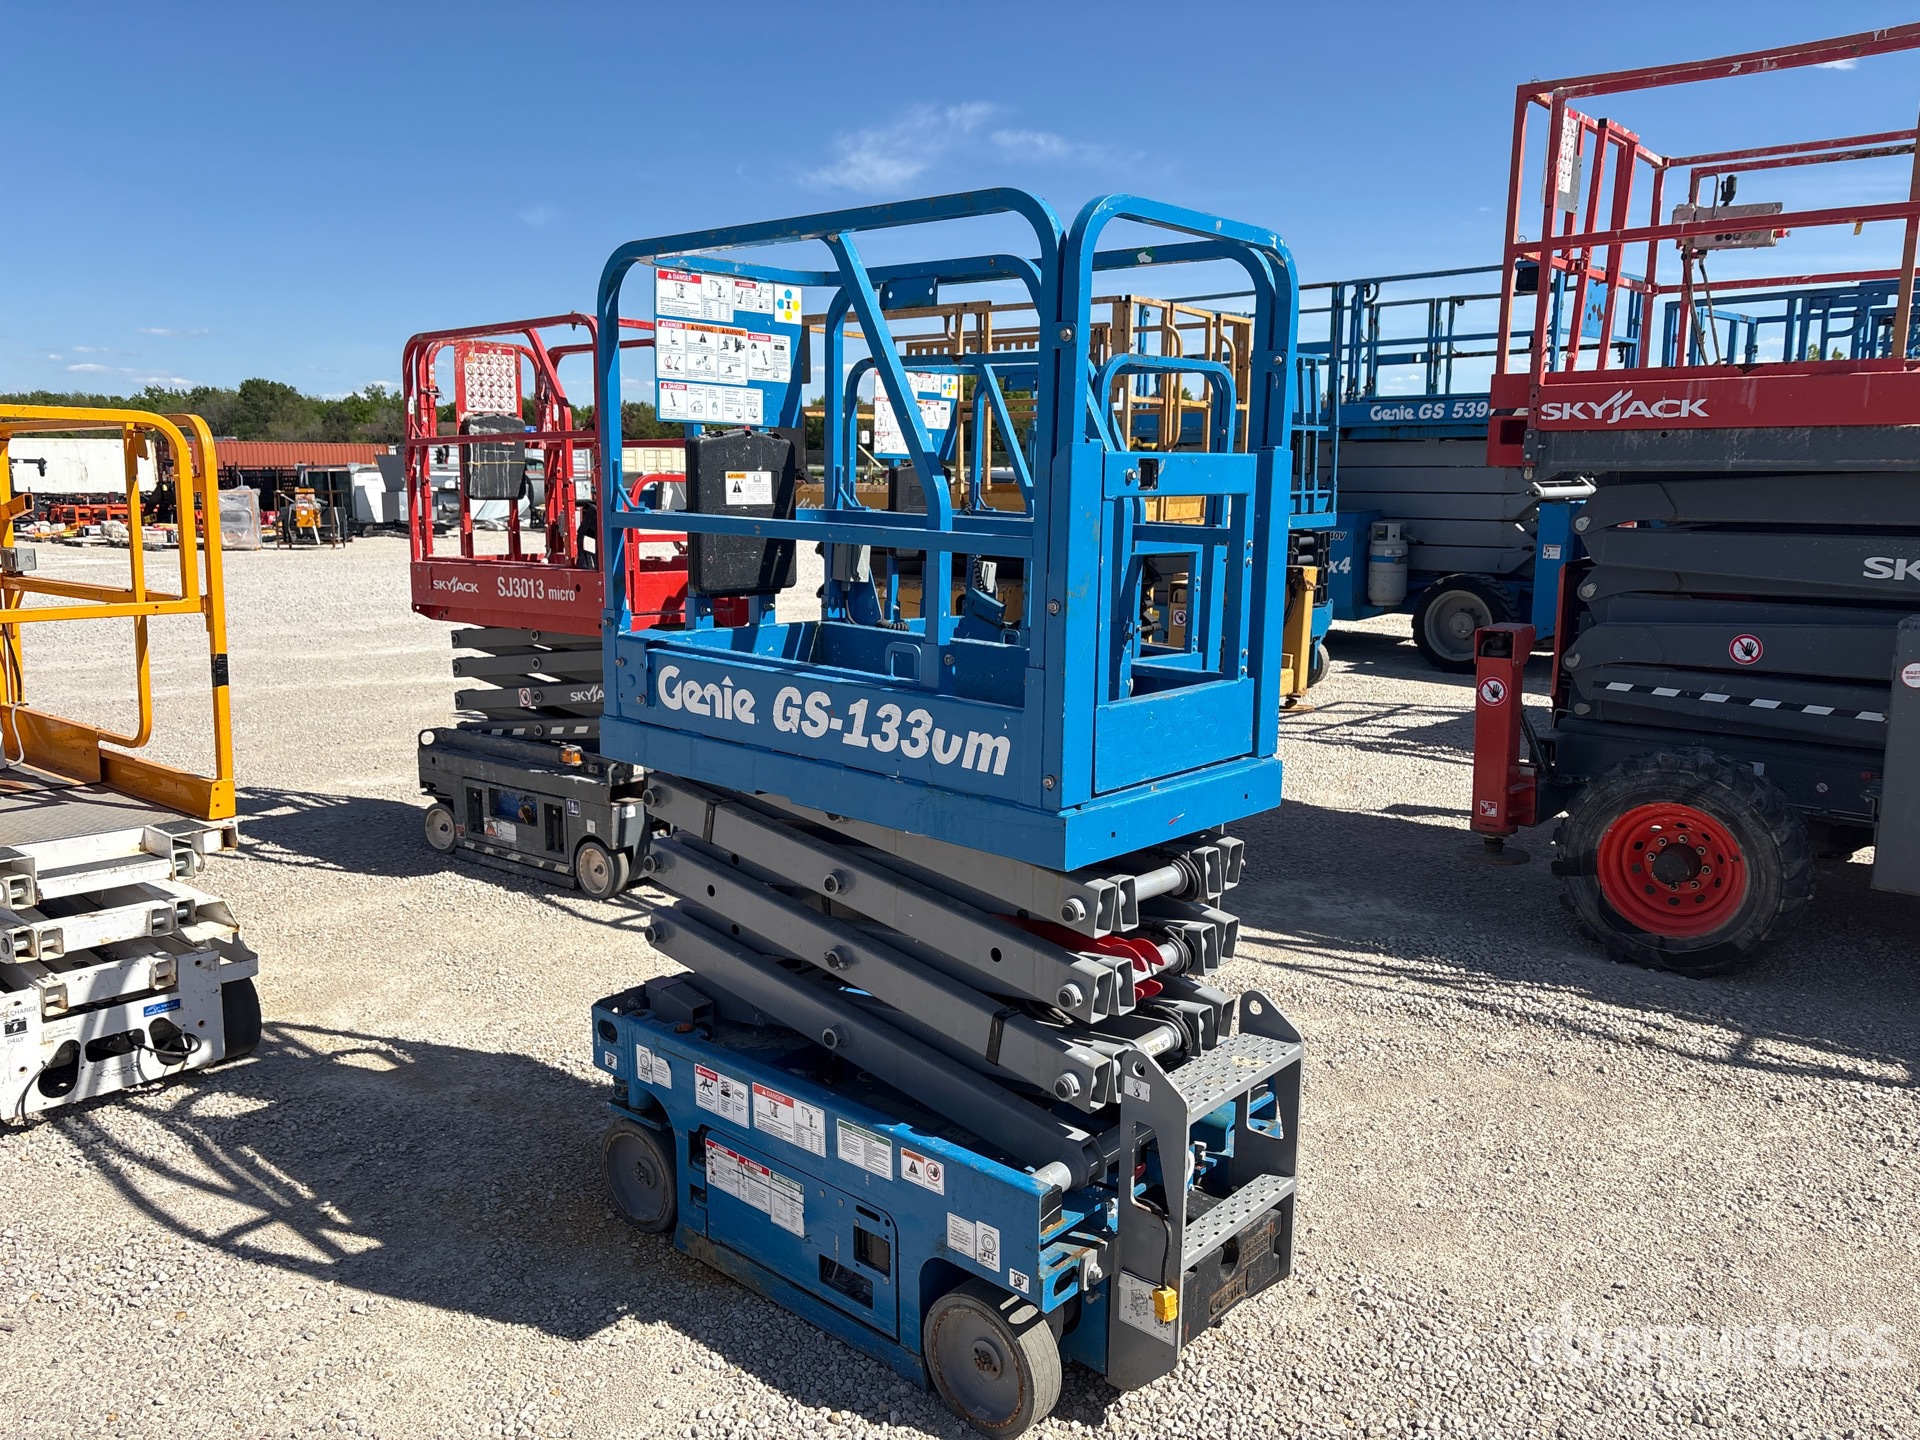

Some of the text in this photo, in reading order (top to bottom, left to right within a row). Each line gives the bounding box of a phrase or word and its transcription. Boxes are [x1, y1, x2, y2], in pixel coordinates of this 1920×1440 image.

[672, 273, 692, 282] DANGER
[666, 321, 683, 329] DANGER
[1370, 401, 1489, 421] Genie GS 539
[1541, 389, 1710, 424] SKYJACK
[433, 576, 479, 594] SKYJACK
[497, 576, 576, 602] SJ3013 micro
[657, 665, 756, 725] Genie
[10, 1005, 37, 1017] CHARGE
[766, 1090, 786, 1103] DANGER
